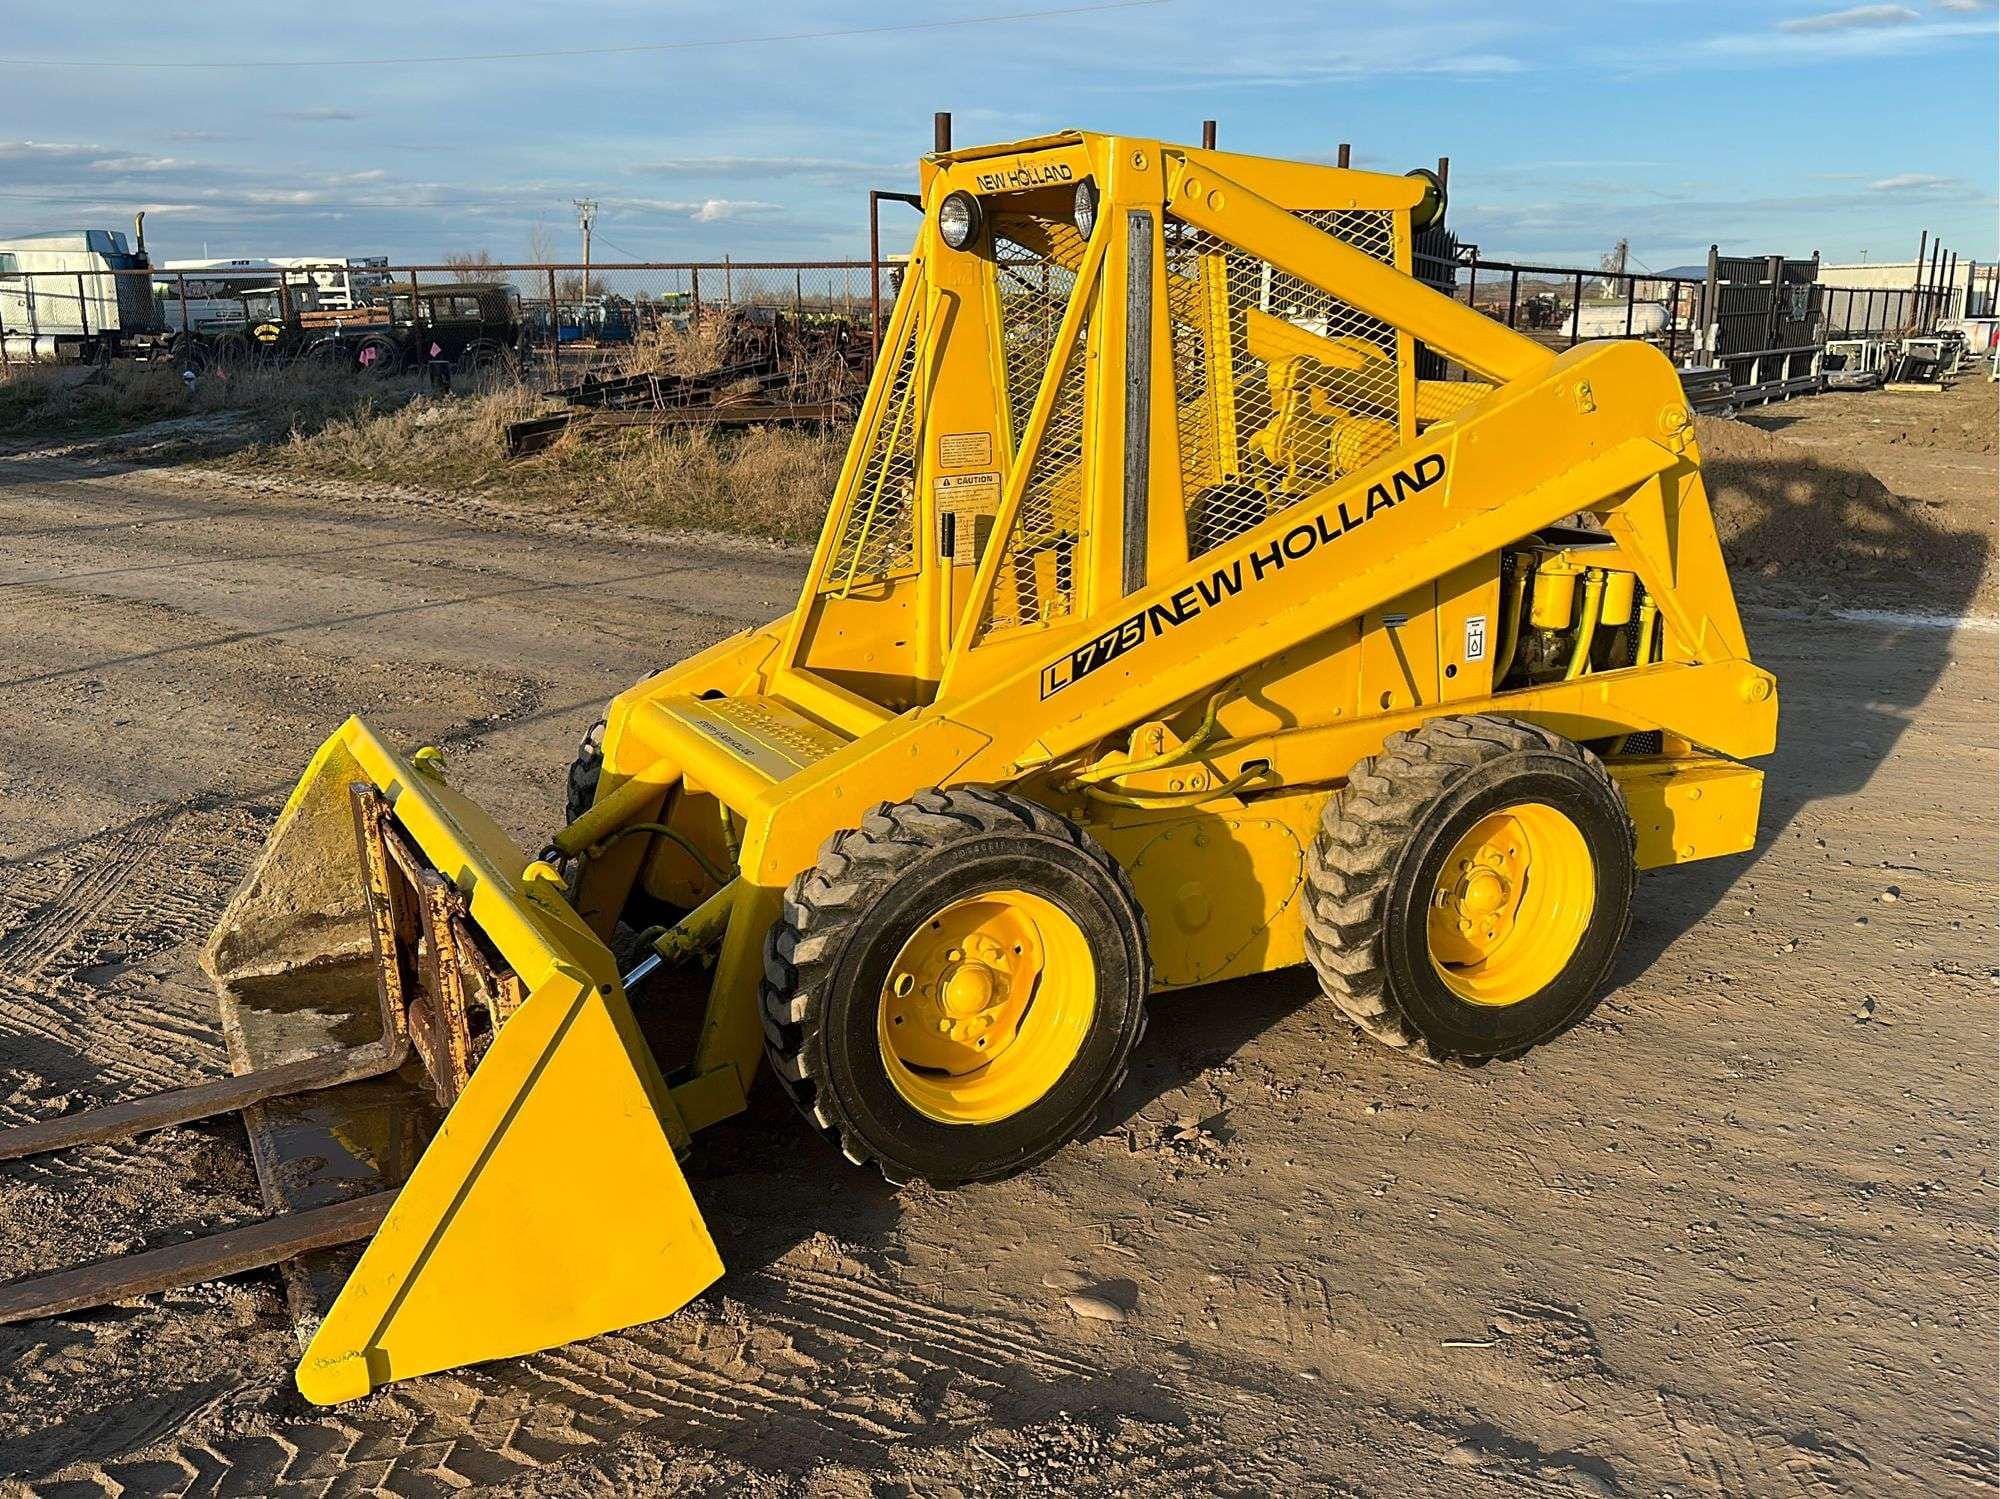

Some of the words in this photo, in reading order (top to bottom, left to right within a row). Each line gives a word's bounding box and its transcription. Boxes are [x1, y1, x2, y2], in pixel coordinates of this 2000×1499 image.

[976, 172, 1006, 191] NEW
[1007, 163, 1073, 188] HOLLAND
[957, 475, 993, 486] CAUTION
[1147, 560, 1243, 637] NEW
[1249, 453, 1446, 582] HOLLAND
